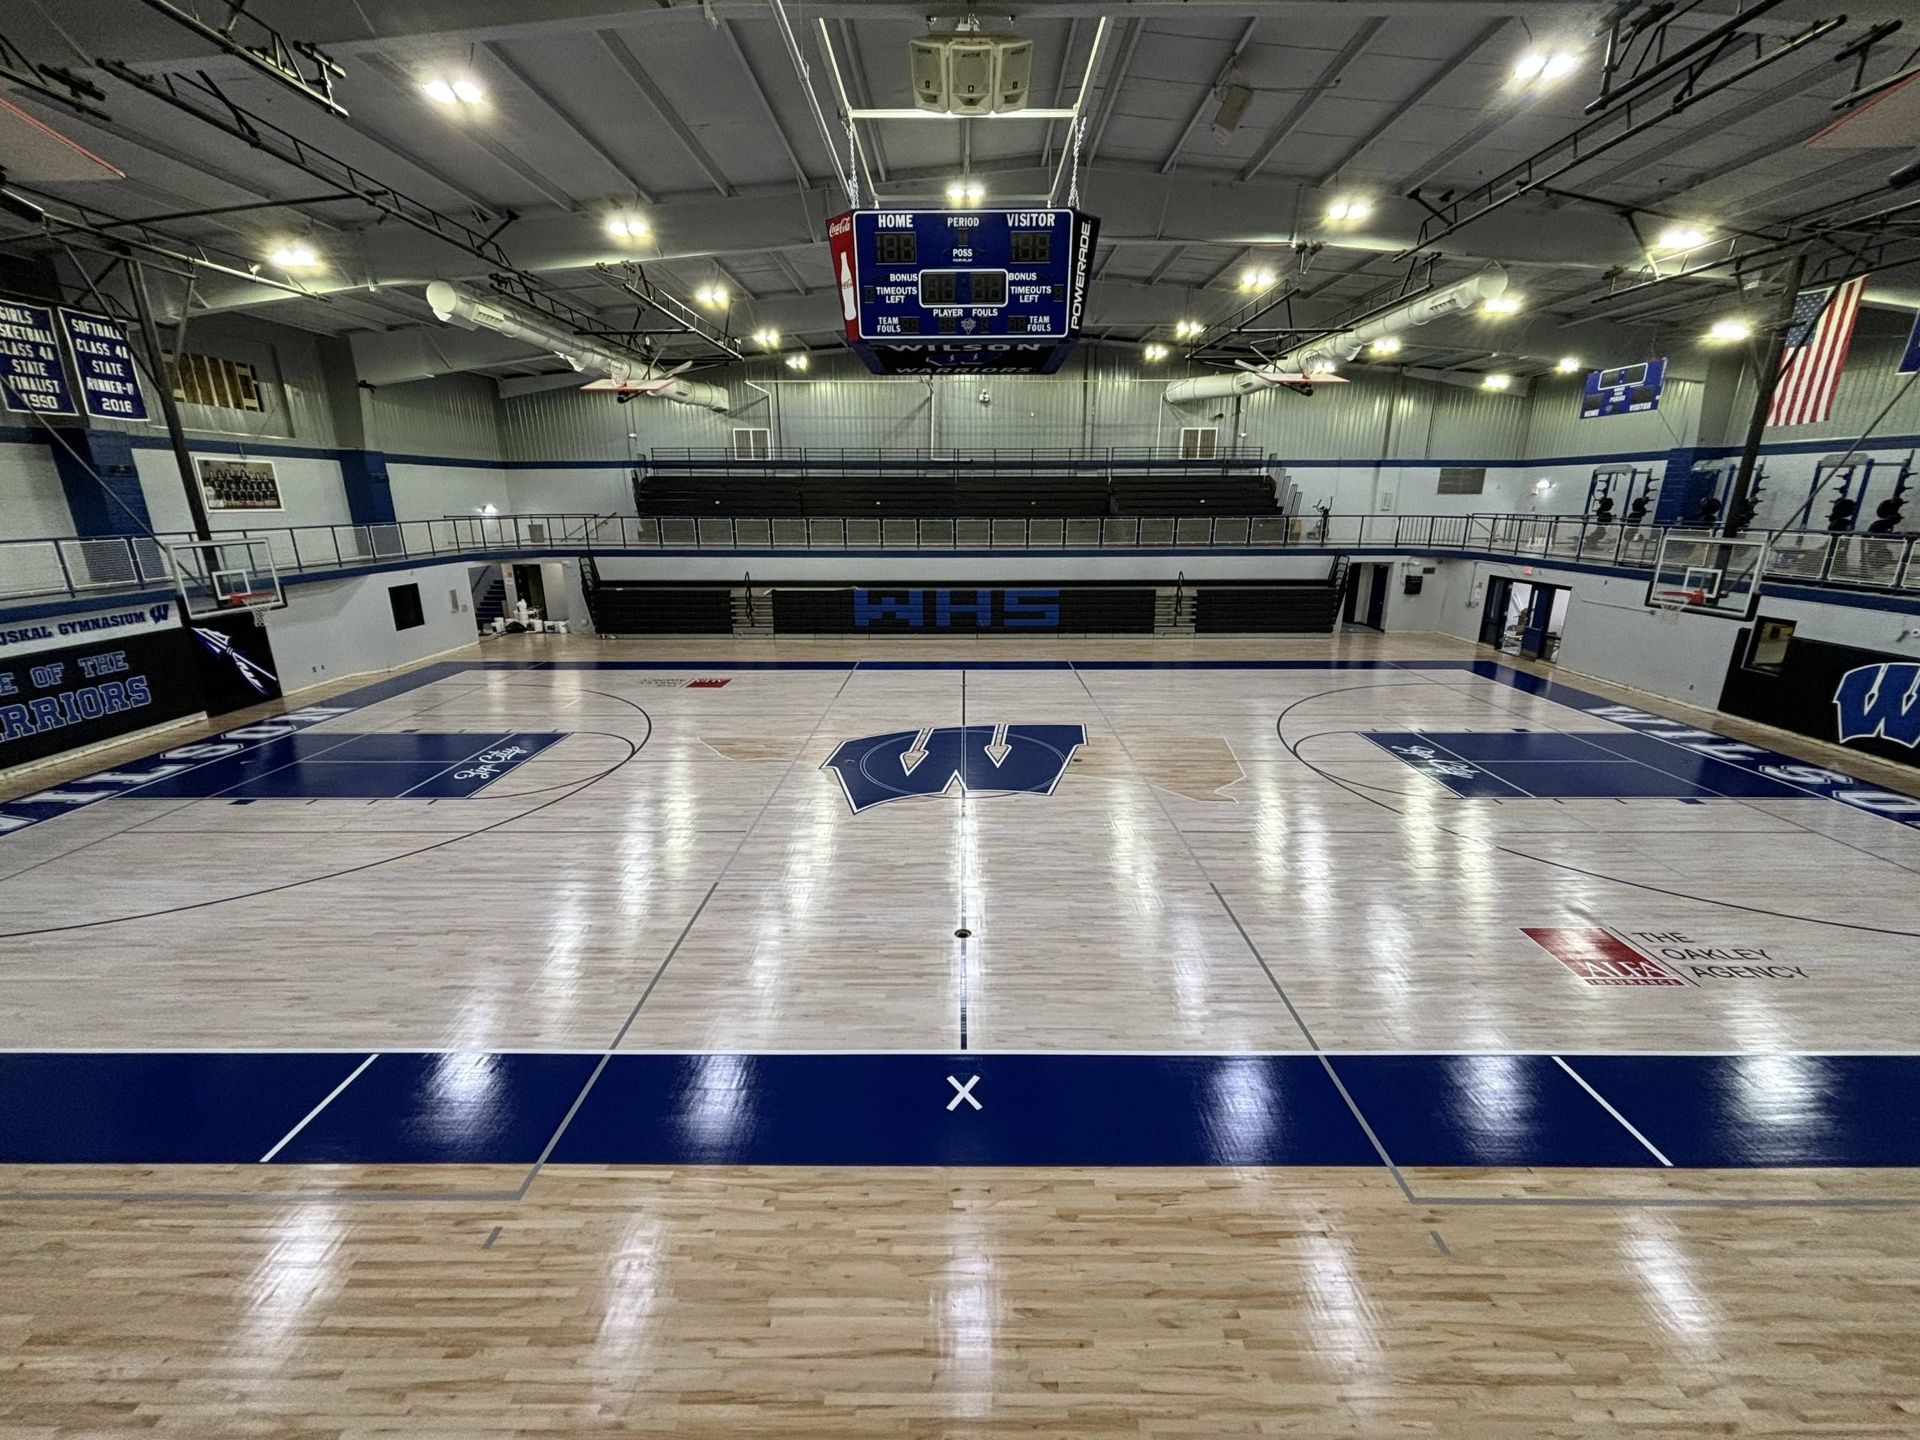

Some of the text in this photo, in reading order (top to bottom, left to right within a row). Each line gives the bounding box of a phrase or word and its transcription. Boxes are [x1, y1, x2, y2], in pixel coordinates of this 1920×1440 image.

[878, 214, 914, 228] HOME
[947, 217, 980, 227] PERIOD
[1007, 213, 1056, 227] VISITOR
[952, 248, 973, 257] POSS
[890, 273, 918, 282] BONUS
[1008, 272, 1037, 281] BONUS
[876, 286, 917, 295] TIMEOUTS
[1010, 285, 1052, 294] TIMEOUTS
[885, 295, 905, 304] LEFT
[1019, 294, 1039, 303] LEFT
[933, 308, 998, 317] PLAYER FOULS
[878, 317, 899, 325] TEAM
[1029, 316, 1050, 324] TEAM
[877, 324, 901, 333] FOULS
[1027, 323, 1051, 332] FOULS
[76, 338, 111, 356] CLASS
[887, 343, 1041, 352] WILSON
[11, 359, 48, 376] STATE
[92, 360, 125, 377] STATE
[8, 375, 60, 394] FINALIST
[854, 588, 1060, 627] WHS
[58, 611, 147, 635] GYMNASIUM
[30, 662, 64, 688] OF
[78, 650, 129, 678] THE
[0, 675, 152, 743] RRIORS
[1632, 931, 1697, 944] THE
[1661, 949, 1773, 961] OAKLEY
[1690, 966, 1811, 979] AGENCY
